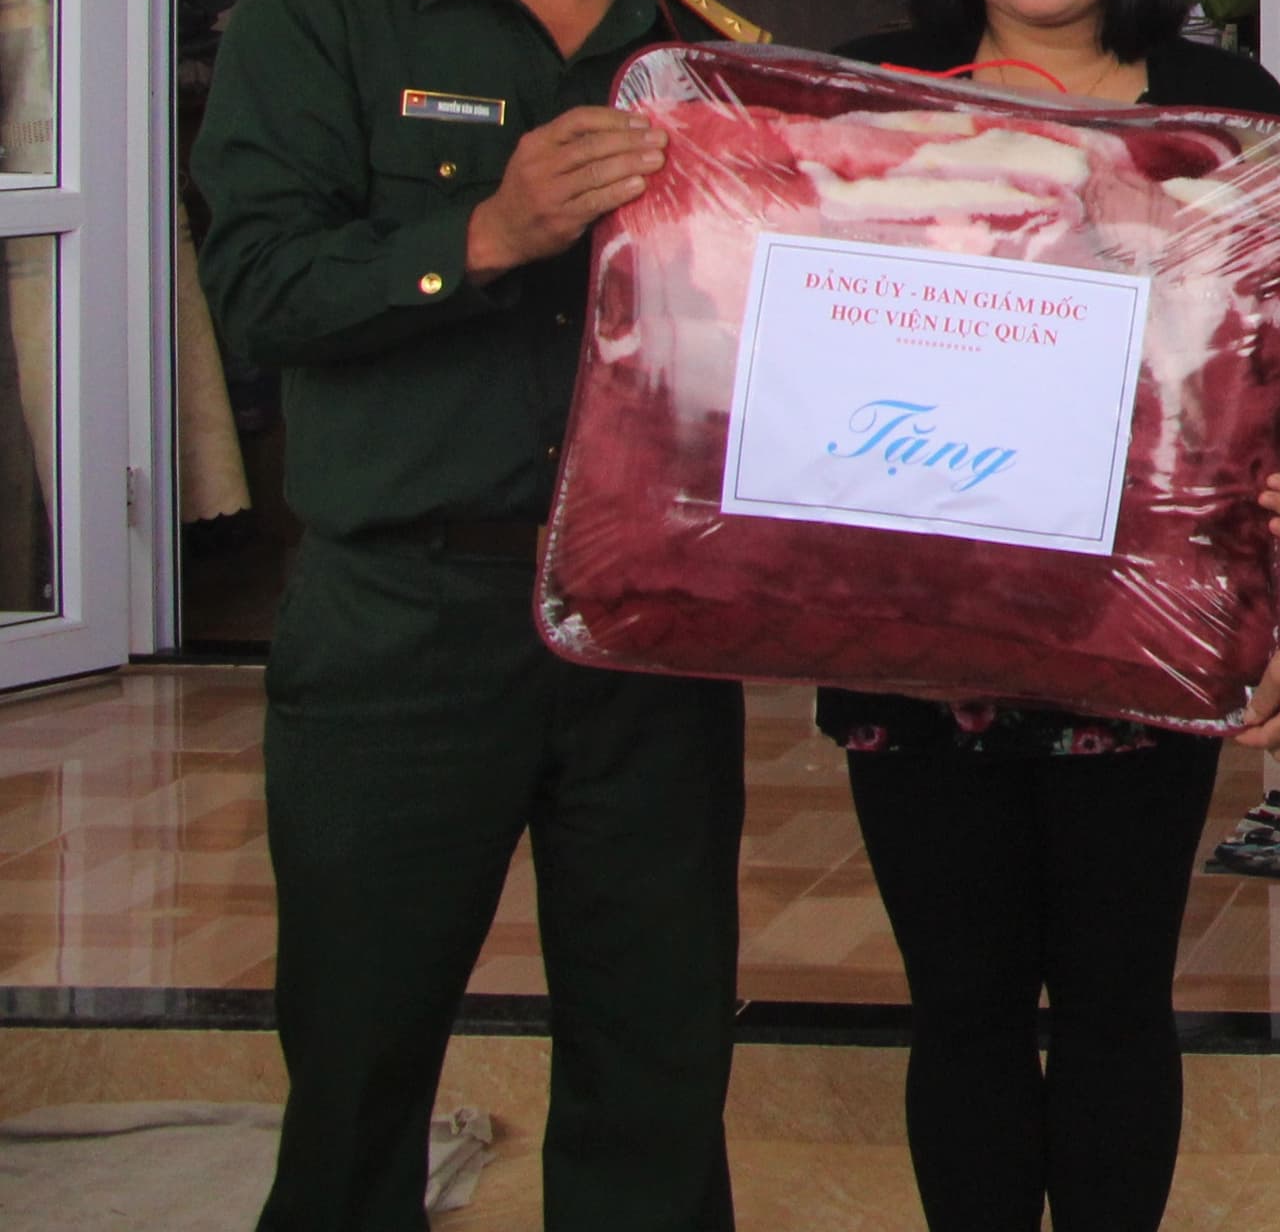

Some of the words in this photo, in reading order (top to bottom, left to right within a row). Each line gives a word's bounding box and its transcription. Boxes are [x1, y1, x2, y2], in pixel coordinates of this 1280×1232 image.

[805, 268, 868, 295] ĐẢNG
[923, 286, 968, 305] BAN
[973, 290, 1035, 315] GIÁM
[1040, 295, 1088, 321] ĐỐC
[830, 304, 879, 326] HỌC
[886, 308, 938, 332] VIỆN
[943, 317, 990, 339] LỤC
[994, 323, 1059, 347] QUÂN
[826, 399, 1018, 493] Tặng
